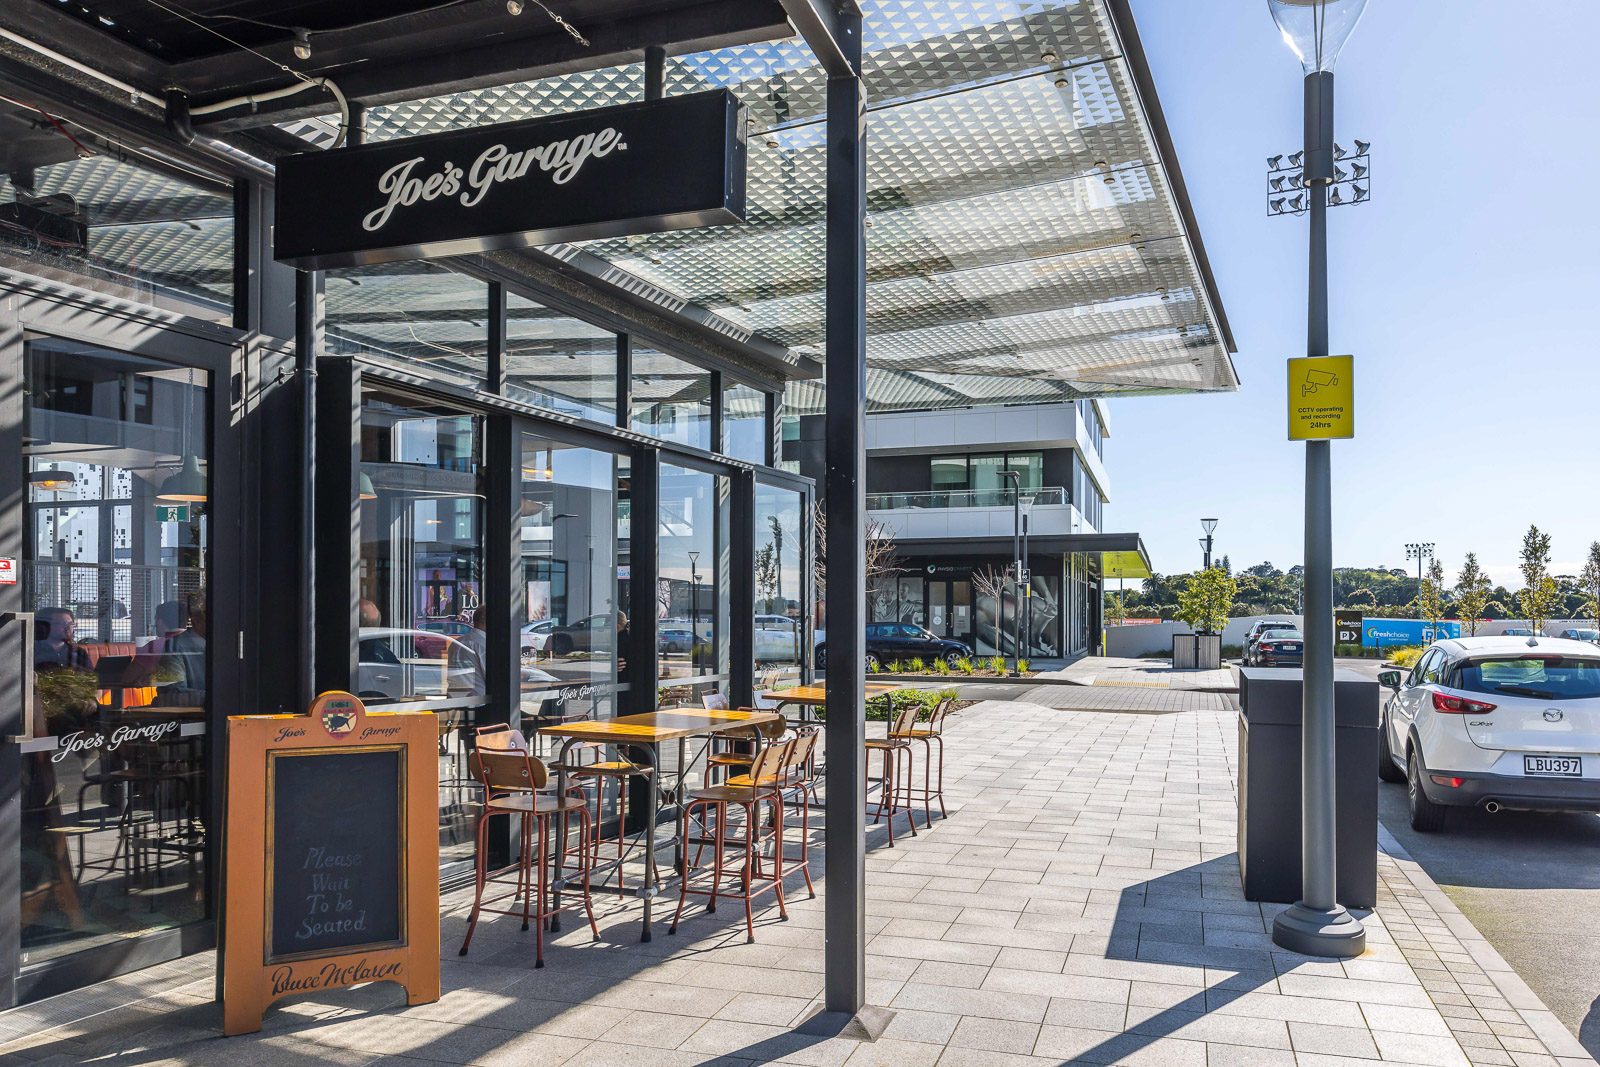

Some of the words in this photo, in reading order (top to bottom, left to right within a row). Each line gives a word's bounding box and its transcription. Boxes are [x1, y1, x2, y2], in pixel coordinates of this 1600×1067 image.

[362, 156, 463, 231] Joe's
[460, 127, 622, 207] Garage
[1373, 630, 1410, 638] freshchoice
[556, 686, 578, 706] Joe's
[51, 730, 105, 763] Joe's
[107, 721, 179, 751] Garage
[273, 726, 306, 742] Joe's
[359, 726, 402, 740] Garage
[1527, 758, 1579, 772] LBU397
[303, 846, 362, 869] Please
[312, 873, 350, 892] Wait
[306, 893, 329, 915] To
[336, 892, 353, 912] be
[295, 909, 367, 939] Seated
[271, 965, 320, 996] Bruce
